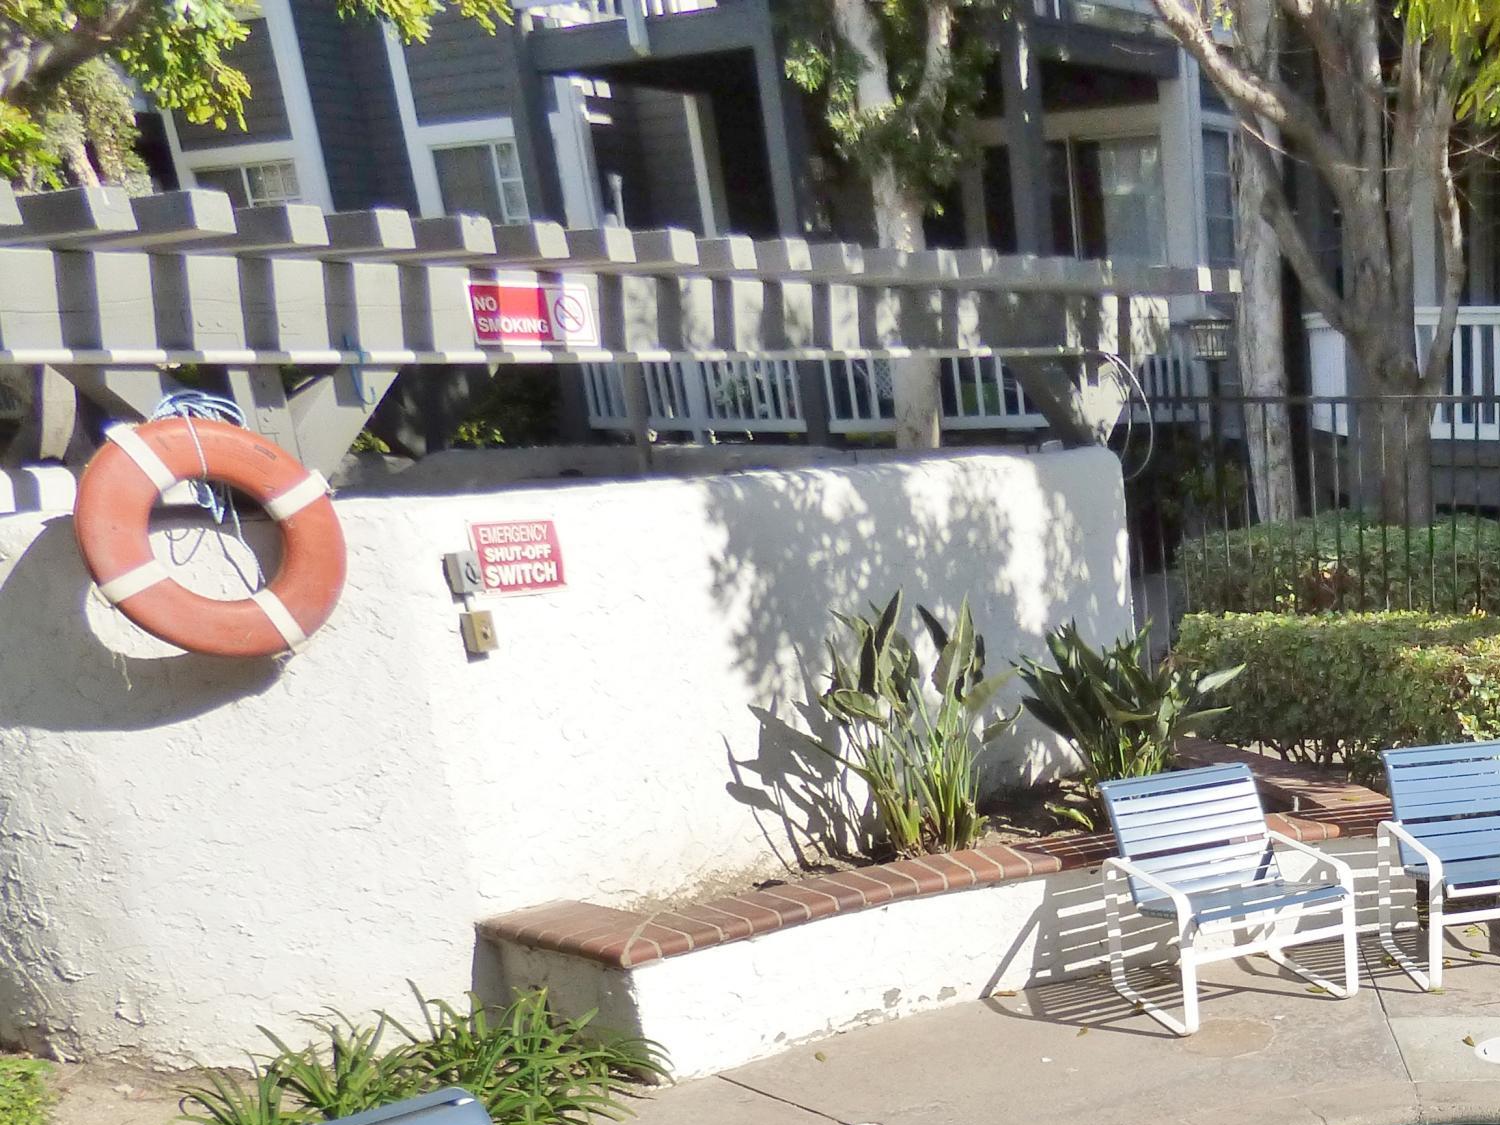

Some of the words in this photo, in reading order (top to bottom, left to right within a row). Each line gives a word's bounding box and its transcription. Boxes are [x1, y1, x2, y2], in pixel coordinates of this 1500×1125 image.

[473, 296, 498, 312] NO
[478, 317, 549, 334] SMOKING
[478, 524, 548, 545] EMERGENCY
[484, 544, 552, 563] SHUT-OFF
[485, 561, 558, 588] SWITCH
